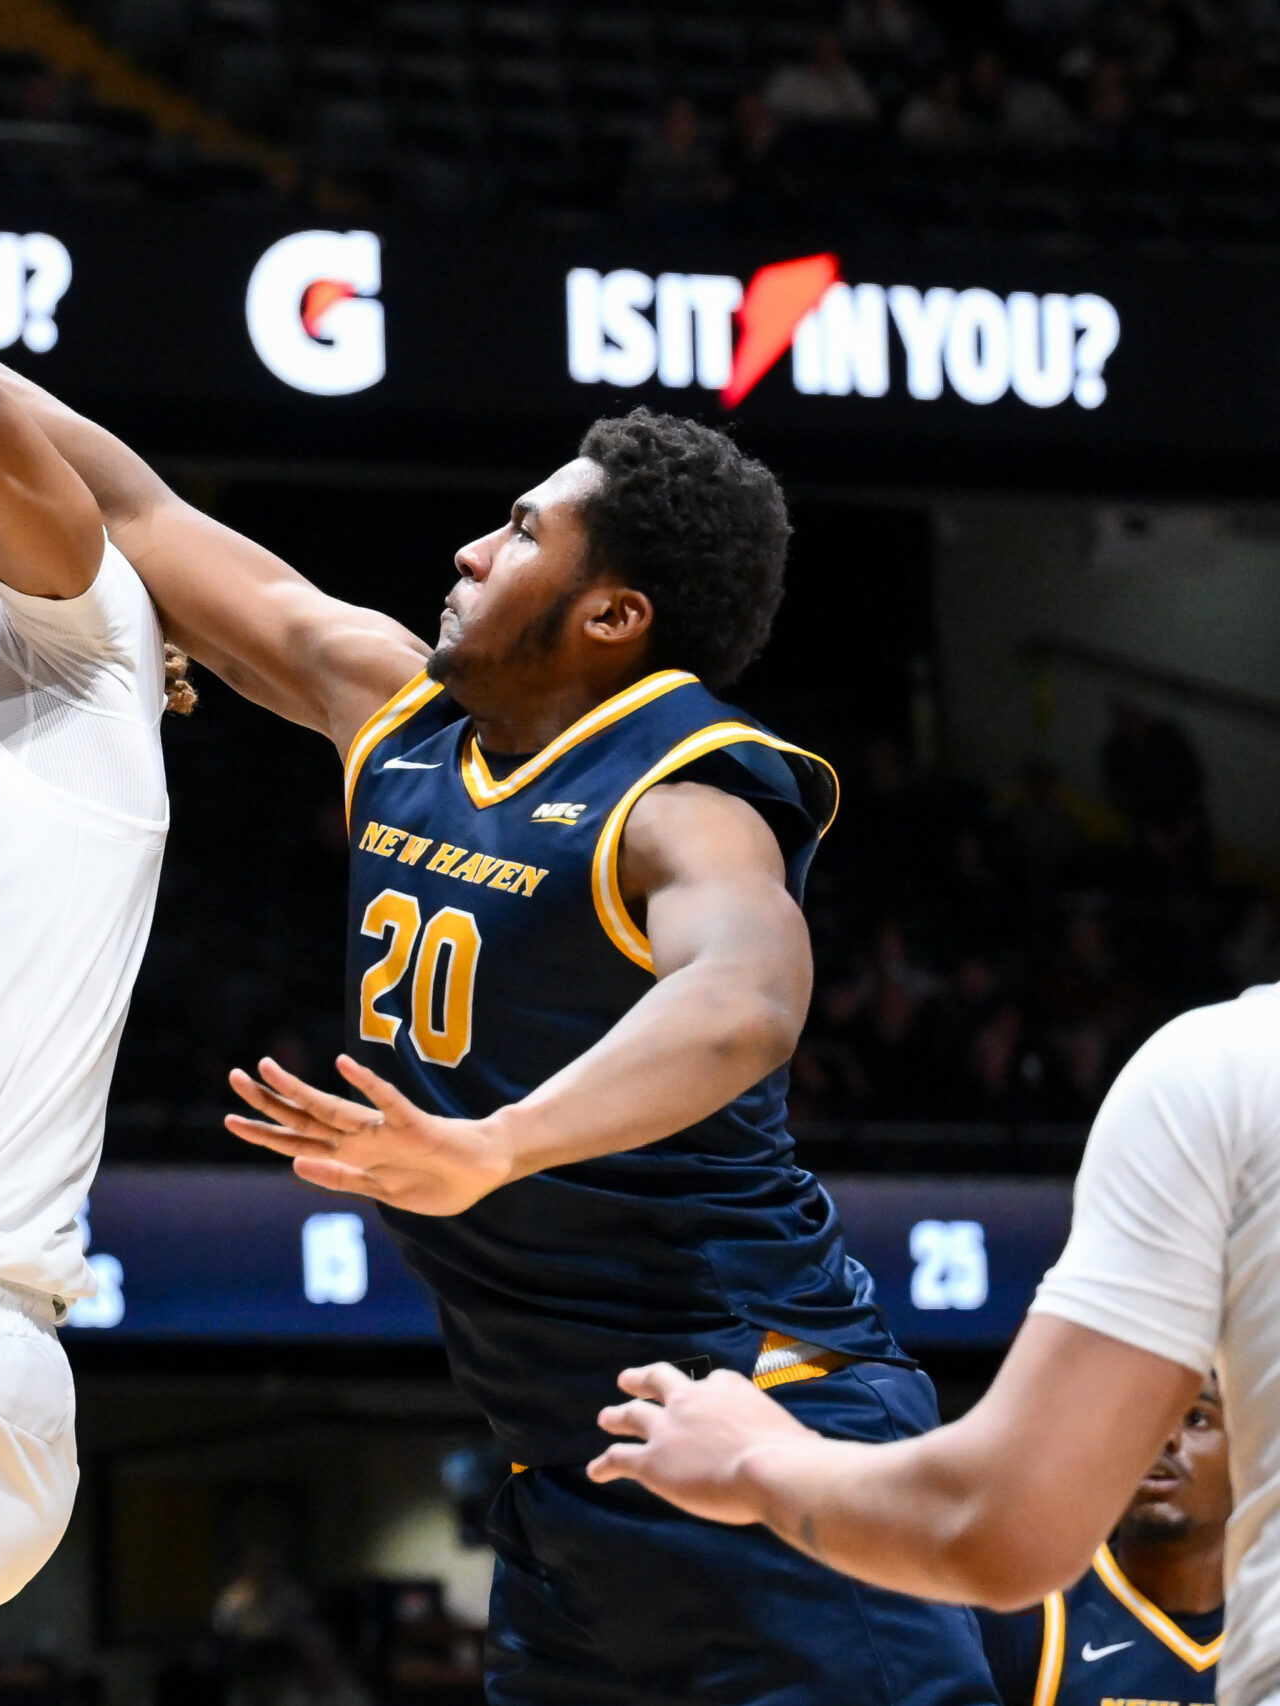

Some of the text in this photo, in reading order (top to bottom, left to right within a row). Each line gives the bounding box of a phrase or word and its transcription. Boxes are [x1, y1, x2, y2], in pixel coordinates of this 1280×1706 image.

[245, 230, 386, 396] G
[566, 267, 658, 388] IS
[655, 271, 744, 391] IT
[886, 283, 1121, 411] YOU?
[358, 820, 550, 898] NEW HAVEN
[531, 802, 588, 820] NEC
[359, 887, 482, 1069] 20
